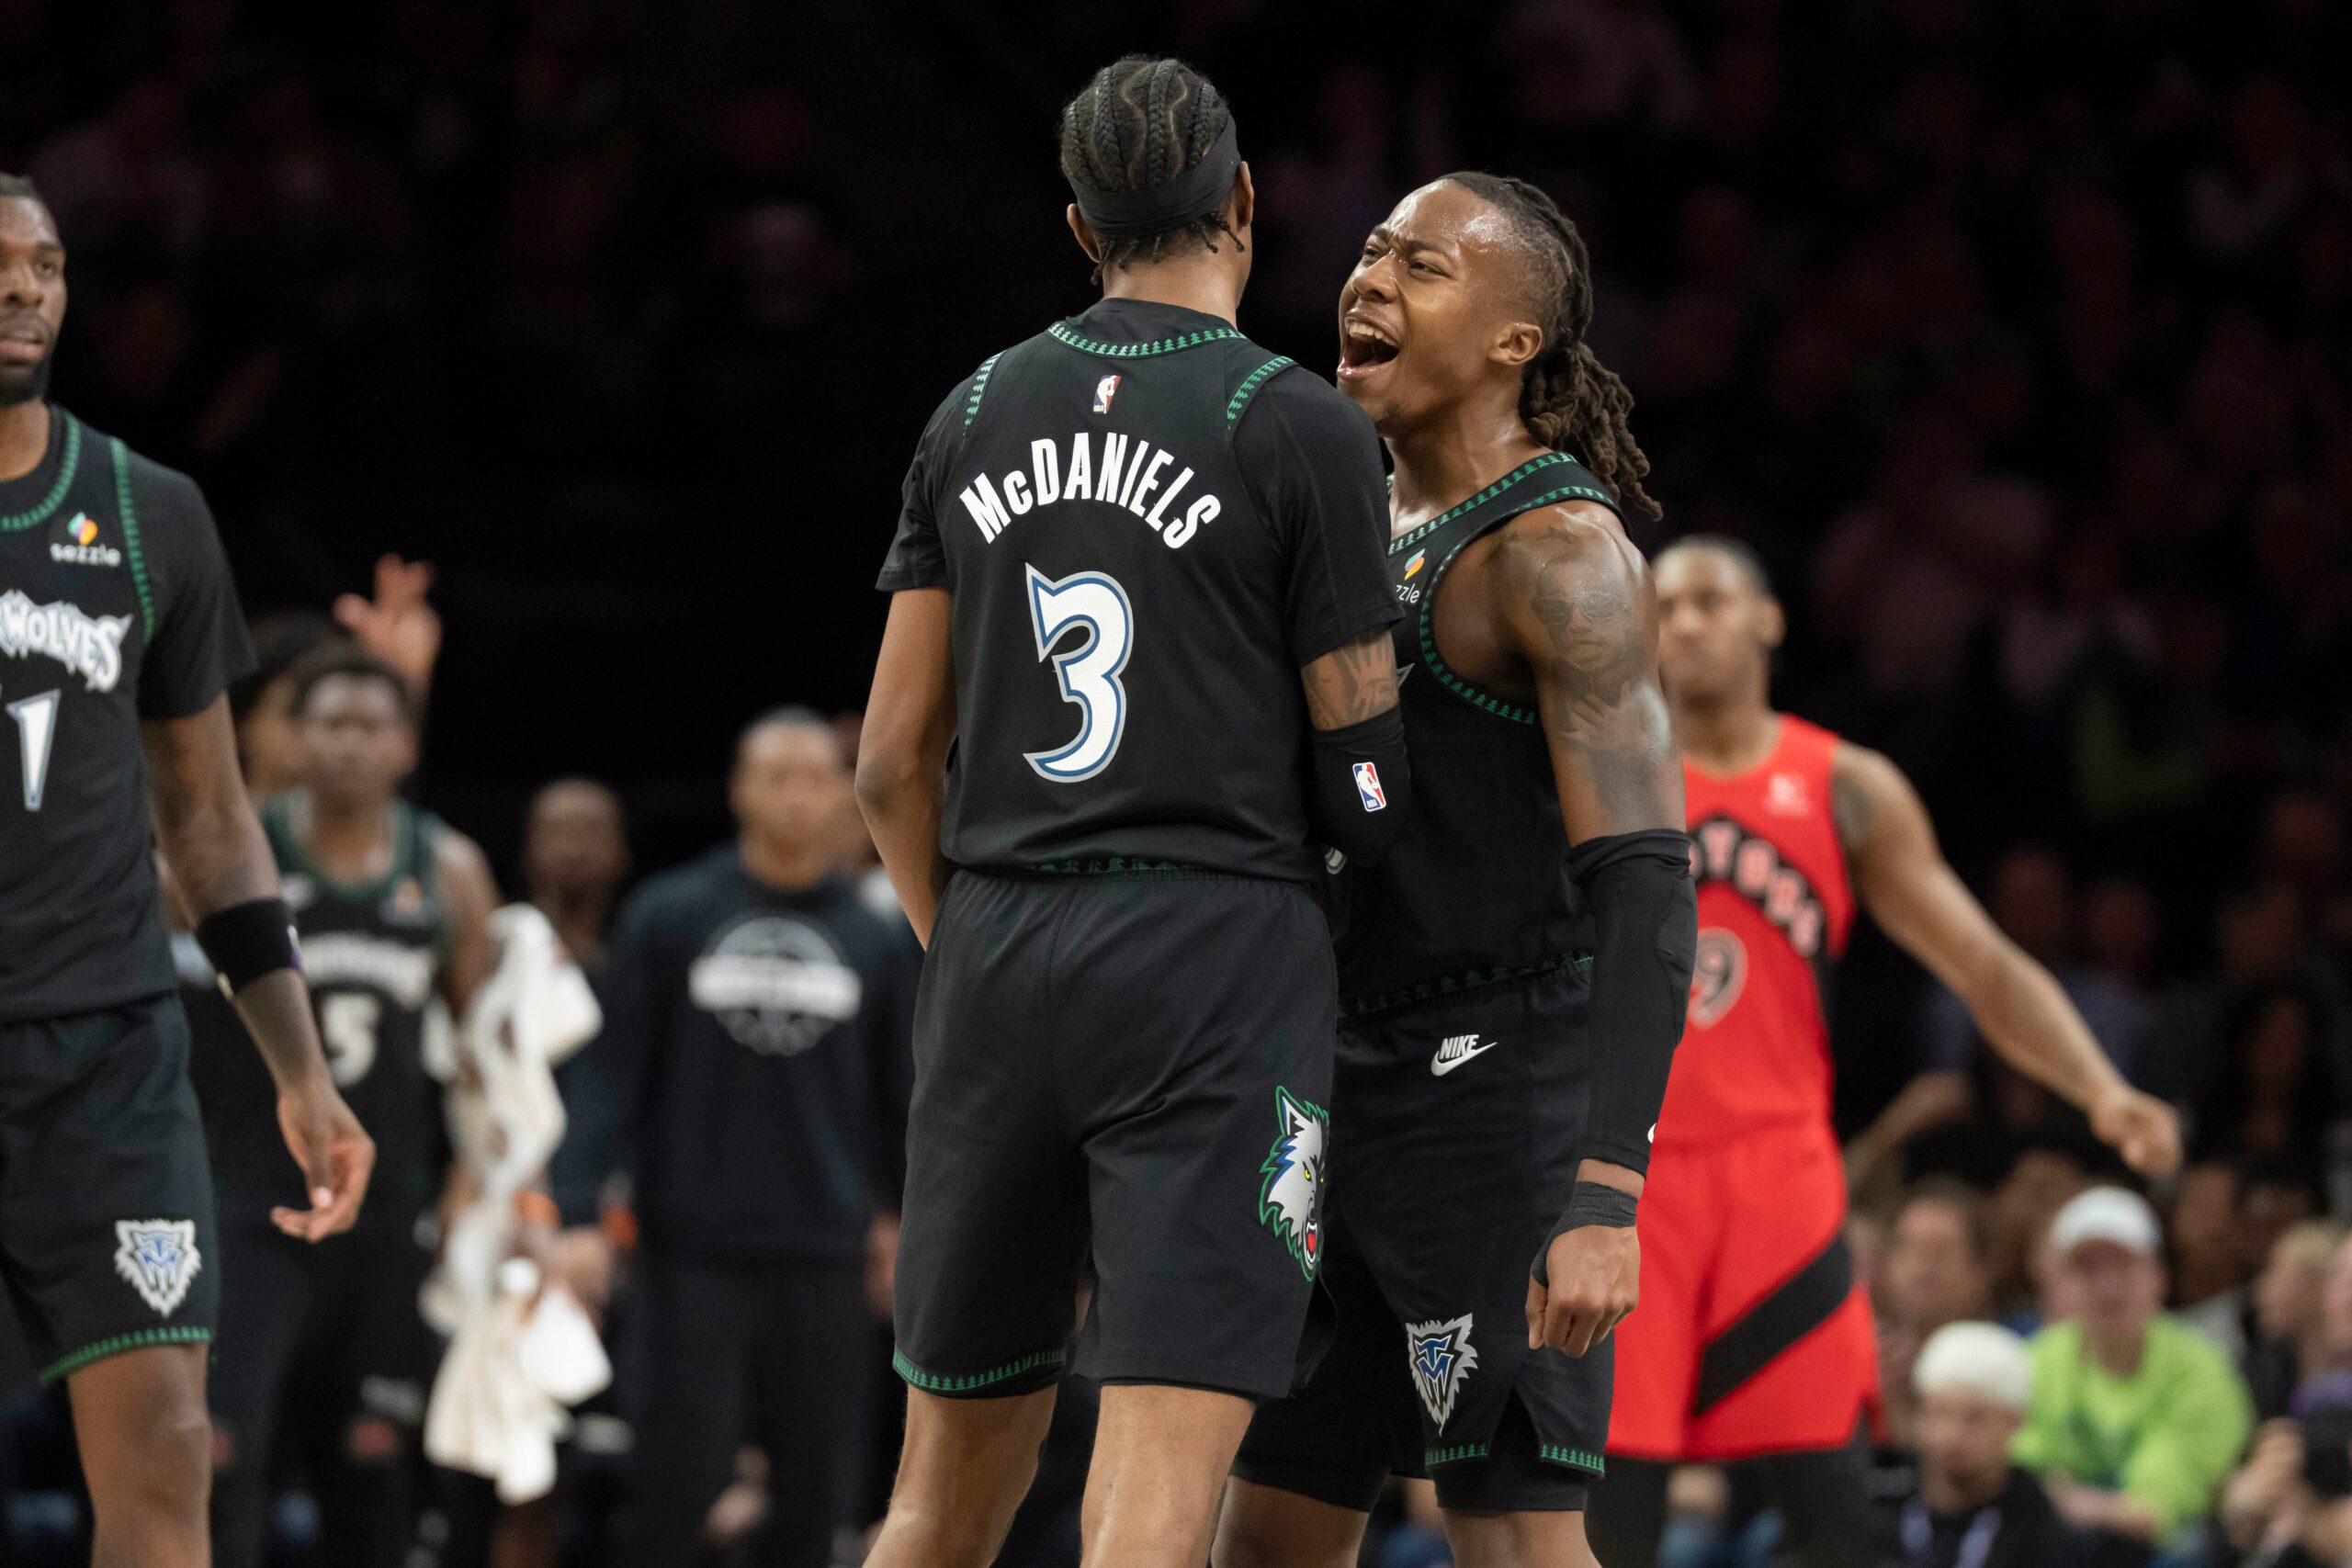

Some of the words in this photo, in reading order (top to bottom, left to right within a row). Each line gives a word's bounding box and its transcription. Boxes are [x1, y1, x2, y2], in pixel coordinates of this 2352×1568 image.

[959, 432, 1221, 549] McDANIELS
[50, 543, 121, 568] sezzle
[0, 588, 134, 693] WOLVES
[1023, 562, 1134, 784] 3
[1439, 1034, 1479, 1060] NIKE
